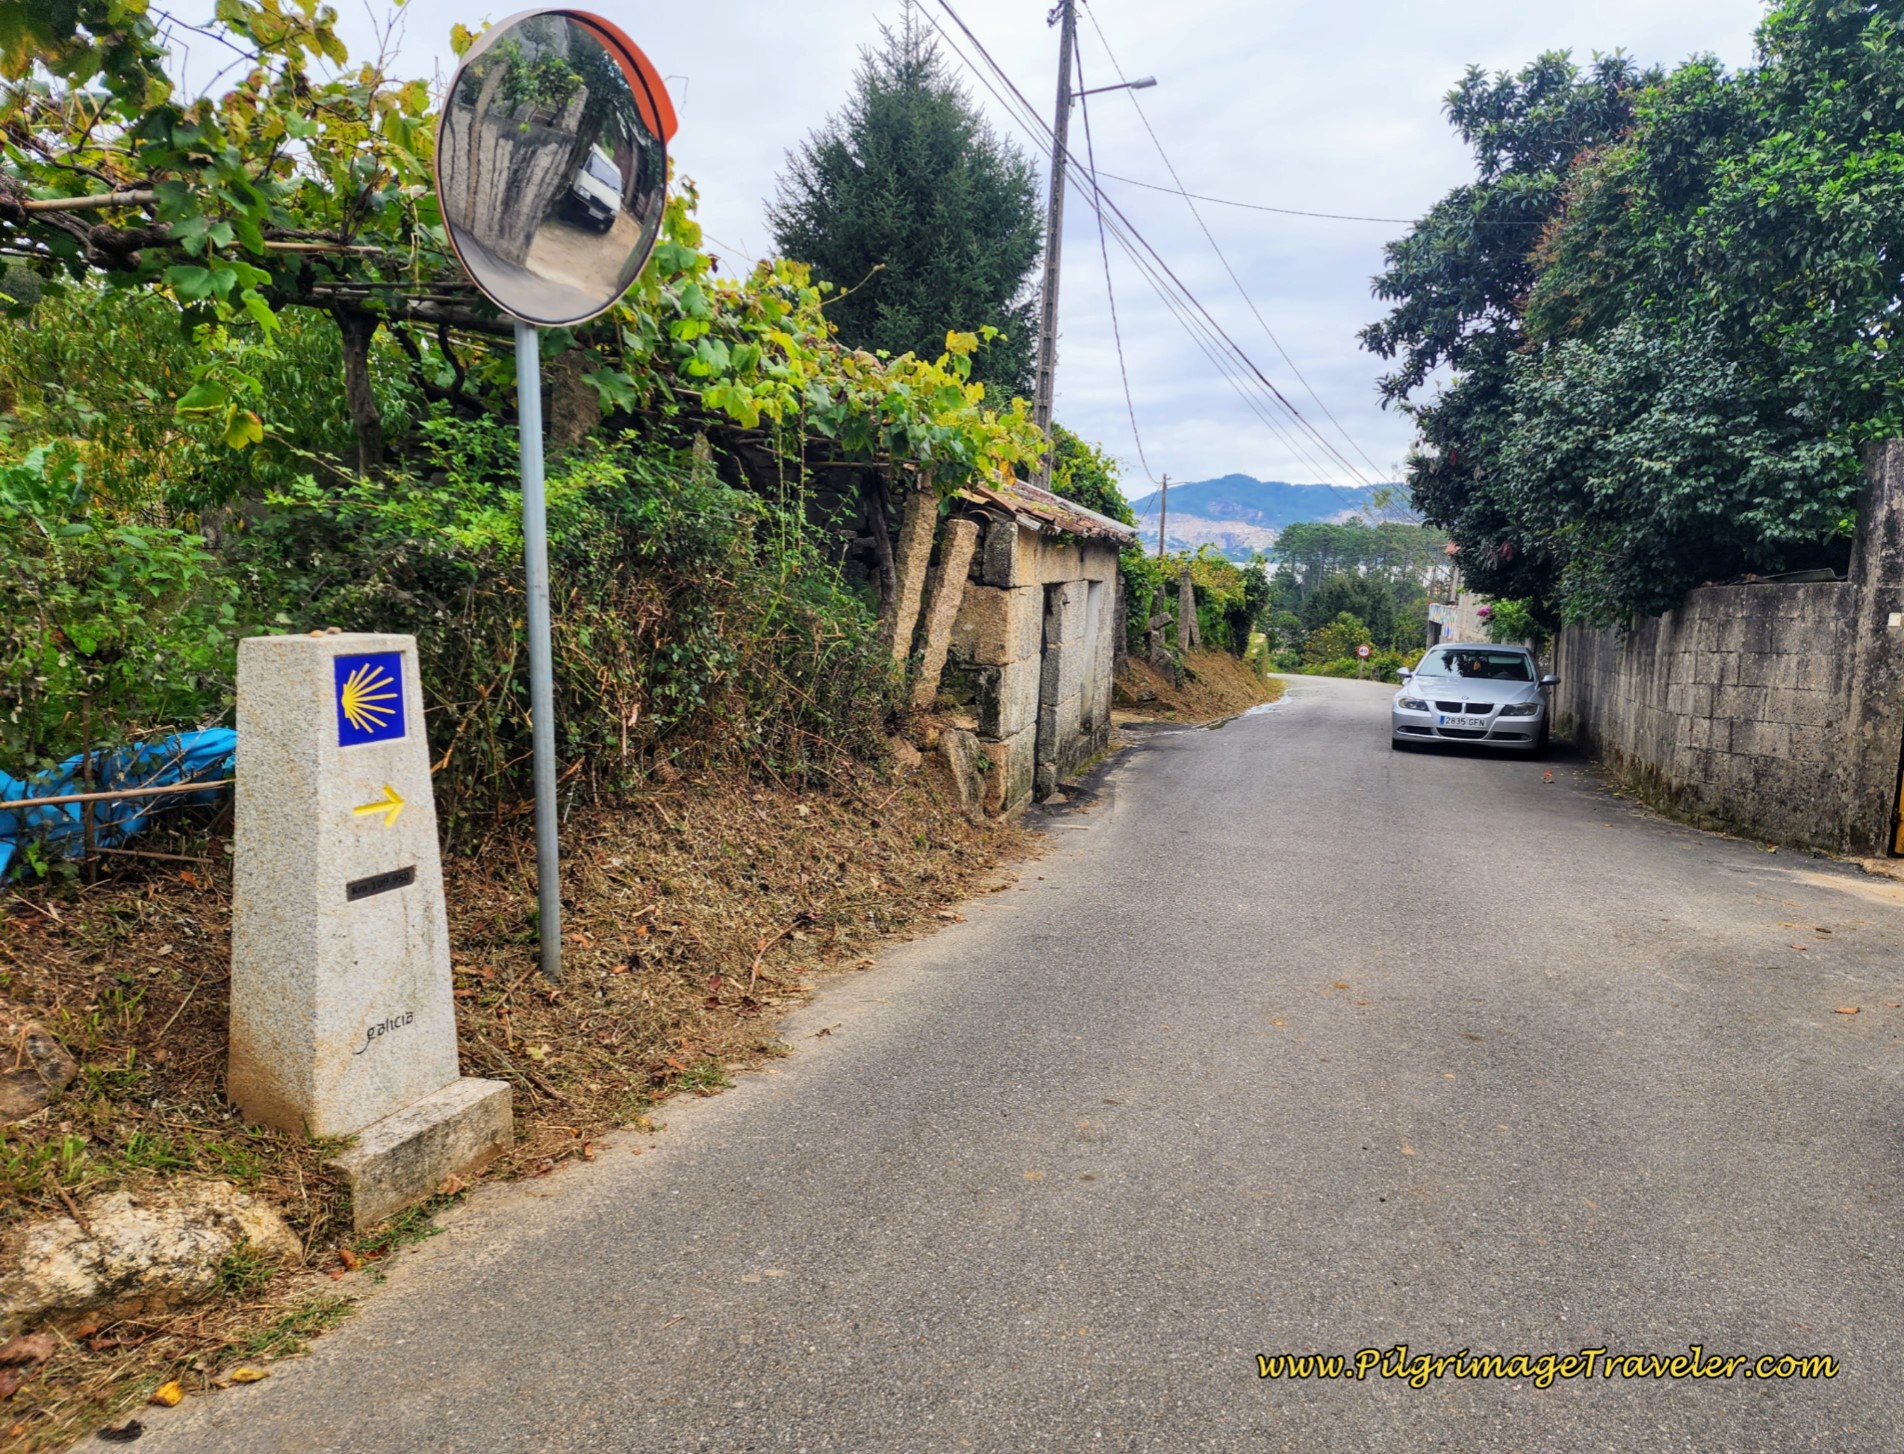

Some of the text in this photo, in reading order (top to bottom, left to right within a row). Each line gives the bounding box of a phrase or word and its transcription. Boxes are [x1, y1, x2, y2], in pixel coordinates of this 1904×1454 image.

[1446, 716, 1485, 727] 2835 GFN
[351, 885, 368, 896] Km
[352, 1011, 414, 1055] galicia
